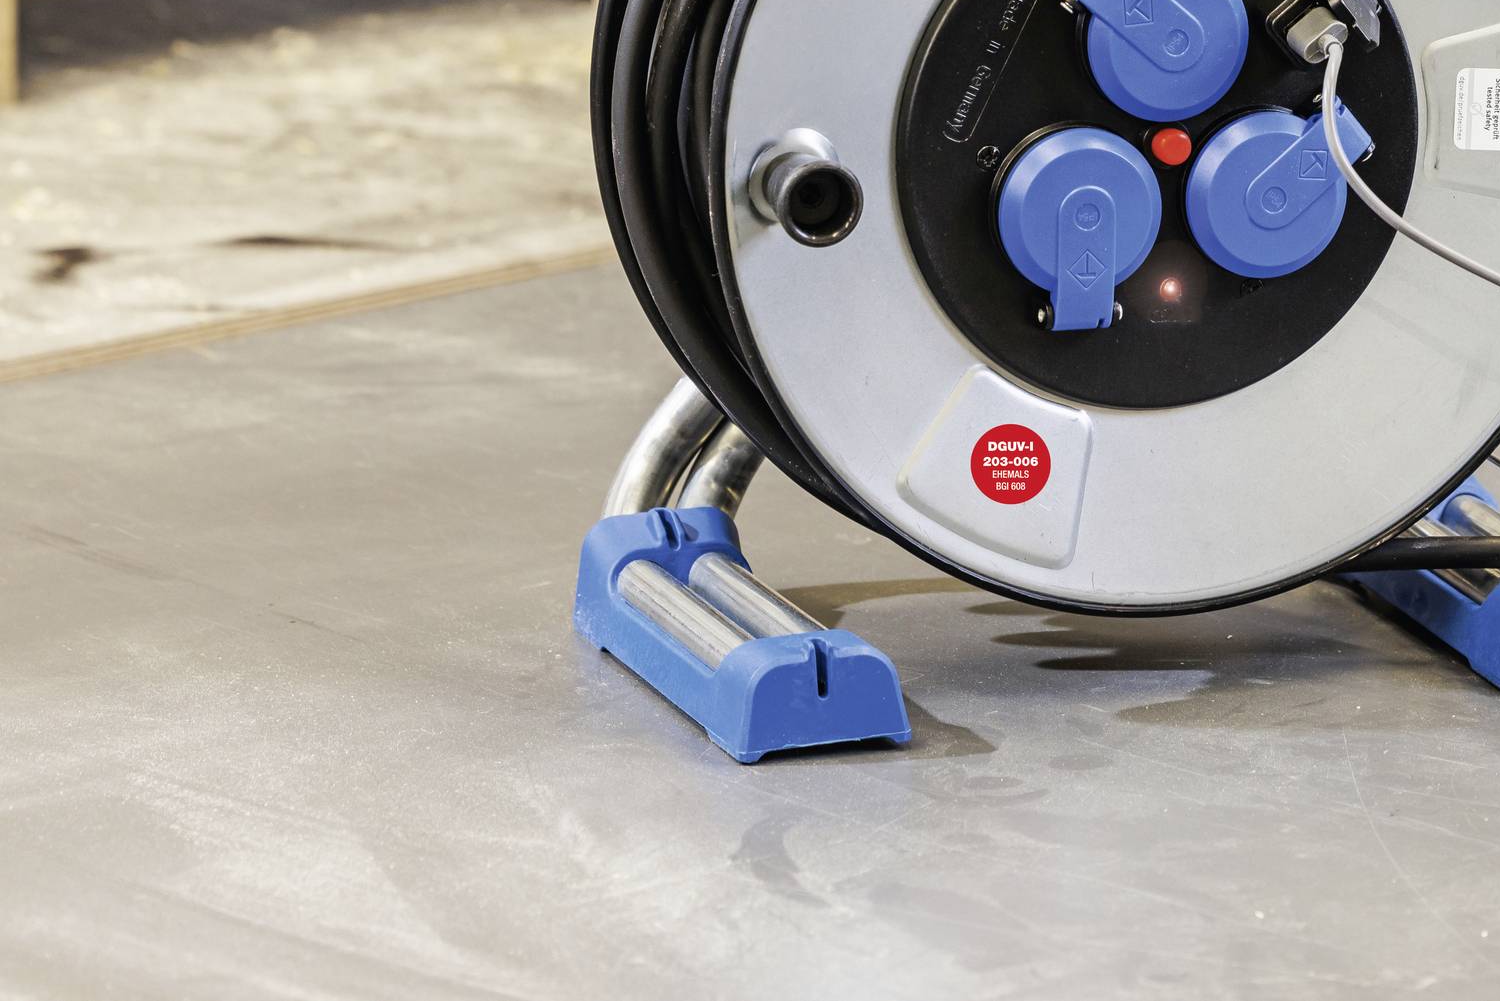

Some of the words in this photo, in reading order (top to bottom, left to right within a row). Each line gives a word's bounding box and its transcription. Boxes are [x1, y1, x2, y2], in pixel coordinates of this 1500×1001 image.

[946, 65, 992, 133] Germany
[1484, 109, 1493, 131] safety
[988, 441, 1034, 451] DGUV-I
[983, 457, 1038, 466] 203-006
[992, 470, 1029, 478] EHEMALS
[996, 482, 1009, 490] BGI
[1011, 482, 1025, 490] 608
